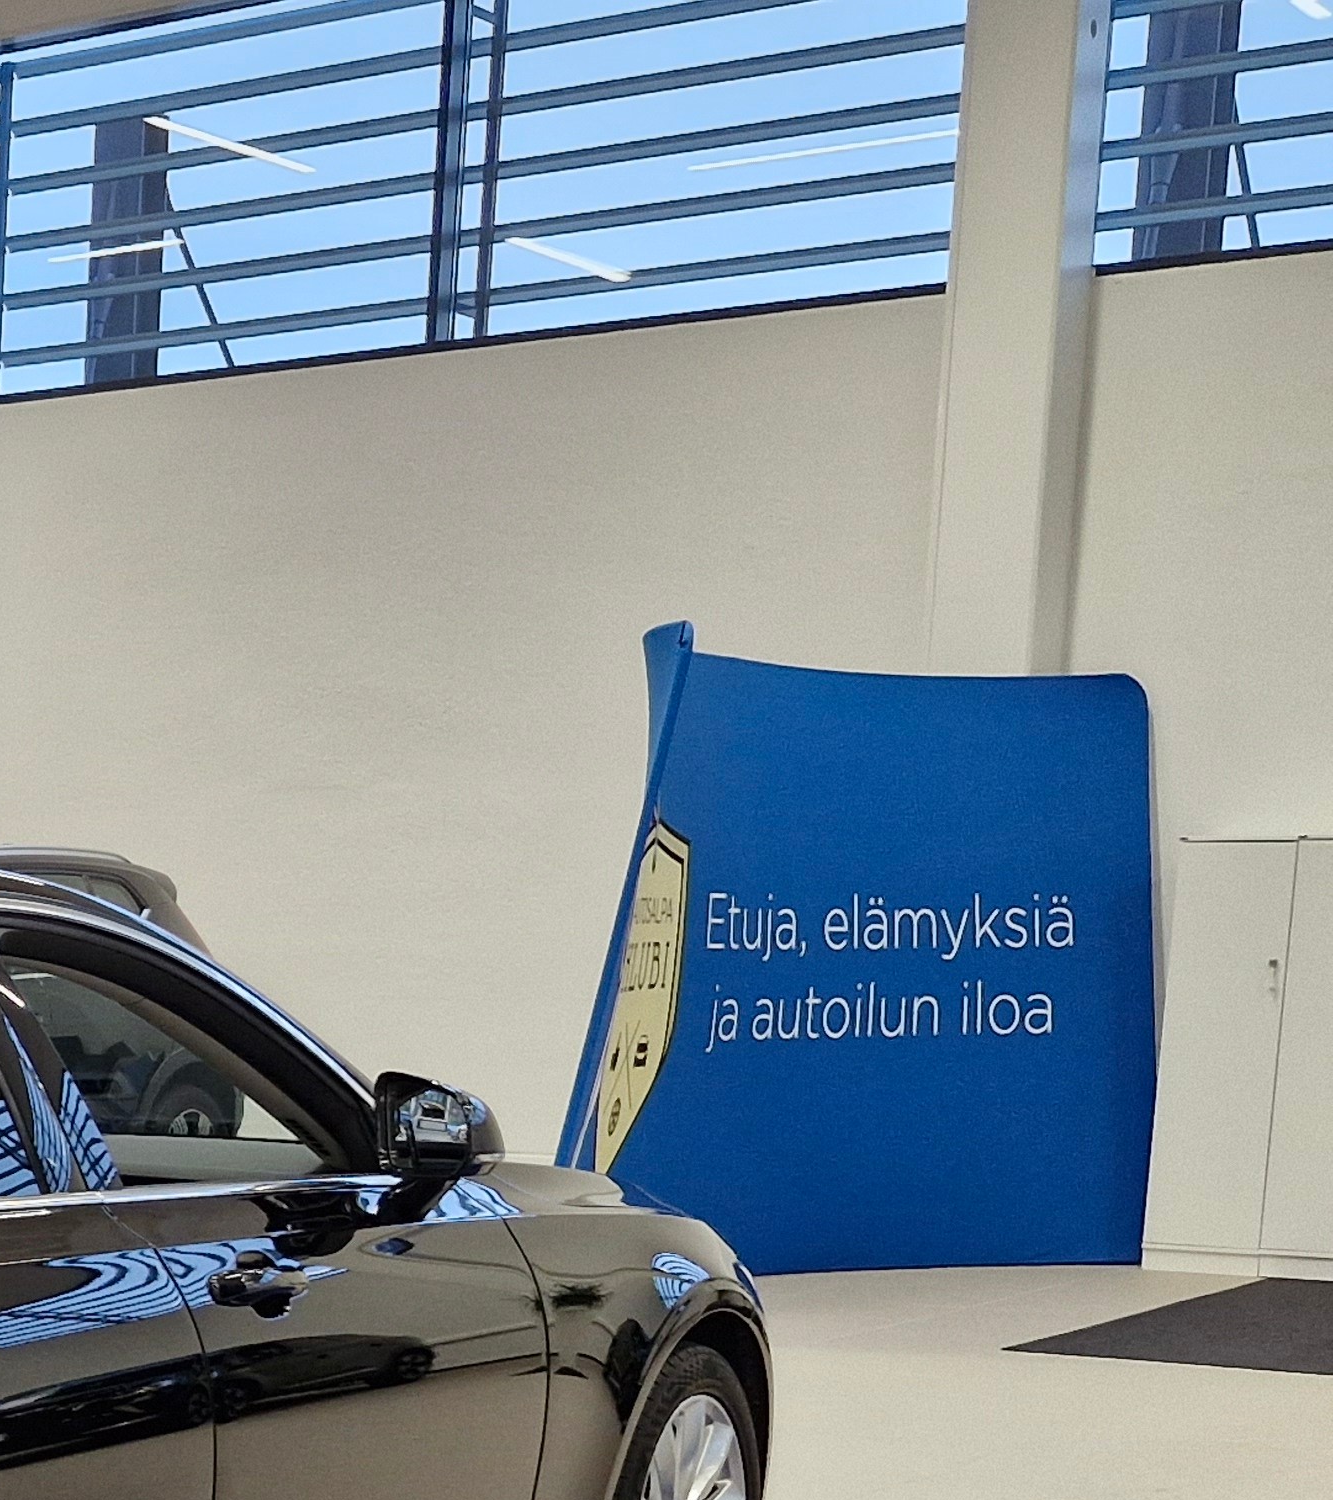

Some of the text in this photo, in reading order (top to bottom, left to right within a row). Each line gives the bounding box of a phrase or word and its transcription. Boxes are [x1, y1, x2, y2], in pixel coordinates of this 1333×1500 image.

[706, 892, 1076, 962] Etuja, elämyksiä
[705, 979, 1054, 1053] ja autoilun iloa
